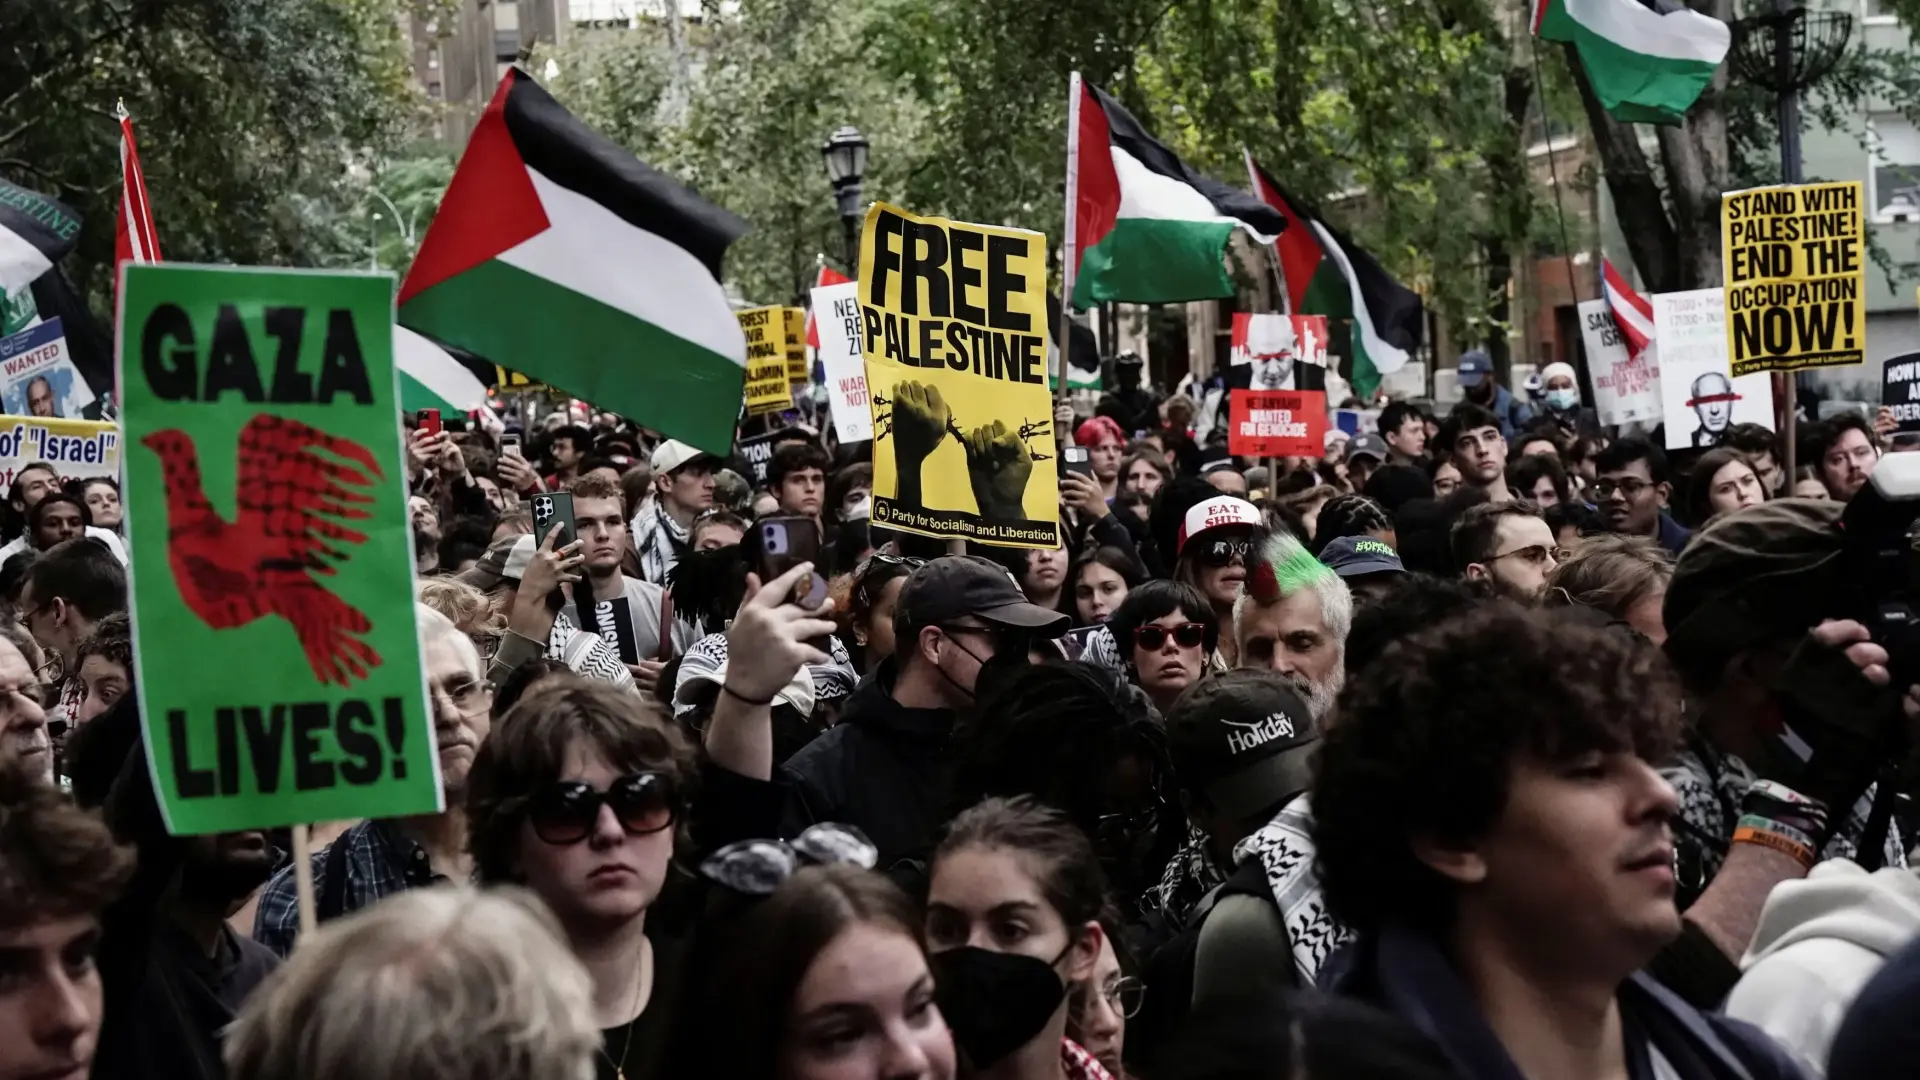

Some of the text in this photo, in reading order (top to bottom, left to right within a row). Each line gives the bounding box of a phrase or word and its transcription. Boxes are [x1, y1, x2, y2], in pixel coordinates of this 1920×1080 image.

[1729, 186, 1856, 219] STAND WITH
[1731, 211, 1857, 246] PALESTINE!
[871, 209, 1032, 332] FREE
[1732, 238, 1858, 282] END THE
[1730, 278, 1857, 311] OCCUPATION
[863, 305, 1044, 384] PALESTINE
[1733, 301, 1854, 360] NOW!
[5, 343, 60, 376] WANTED
[141, 302, 375, 406] GAZA
[839, 376, 866, 394] WAR
[1887, 362, 1914, 384] HOW
[846, 391, 867, 407] NOT
[0, 426, 115, 464] of "Israel"
[892, 508, 915, 526] Party
[917, 512, 929, 526] for
[930, 517, 975, 533] Socialism
[977, 525, 996, 536] and
[999, 525, 1055, 541] Liberation
[1205, 515, 1242, 528] SHIT
[1208, 504, 1240, 516] EAT
[166, 696, 407, 799] LIVES!
